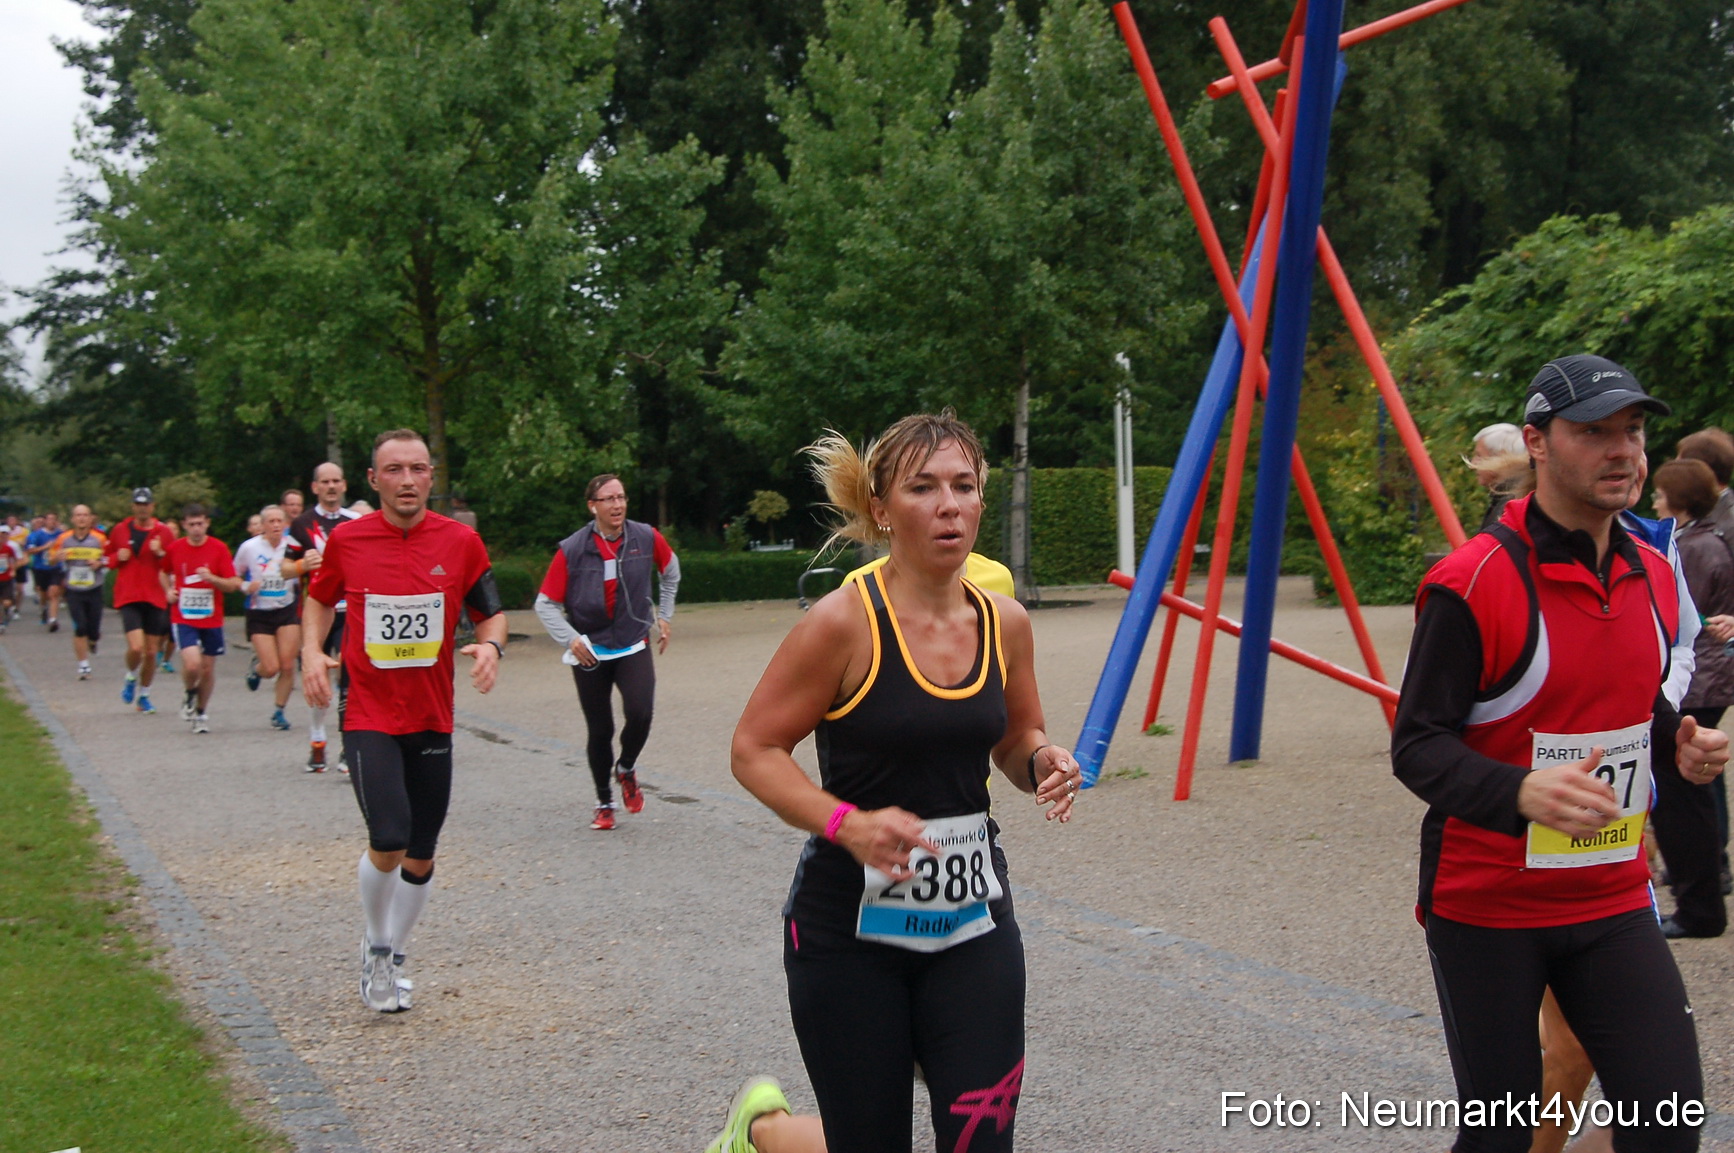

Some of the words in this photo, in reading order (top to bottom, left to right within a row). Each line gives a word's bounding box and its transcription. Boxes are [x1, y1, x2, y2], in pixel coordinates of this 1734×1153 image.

[381, 612, 429, 640] 323
[394, 647, 416, 657] Veit
[1536, 747, 1585, 760] PARTL
